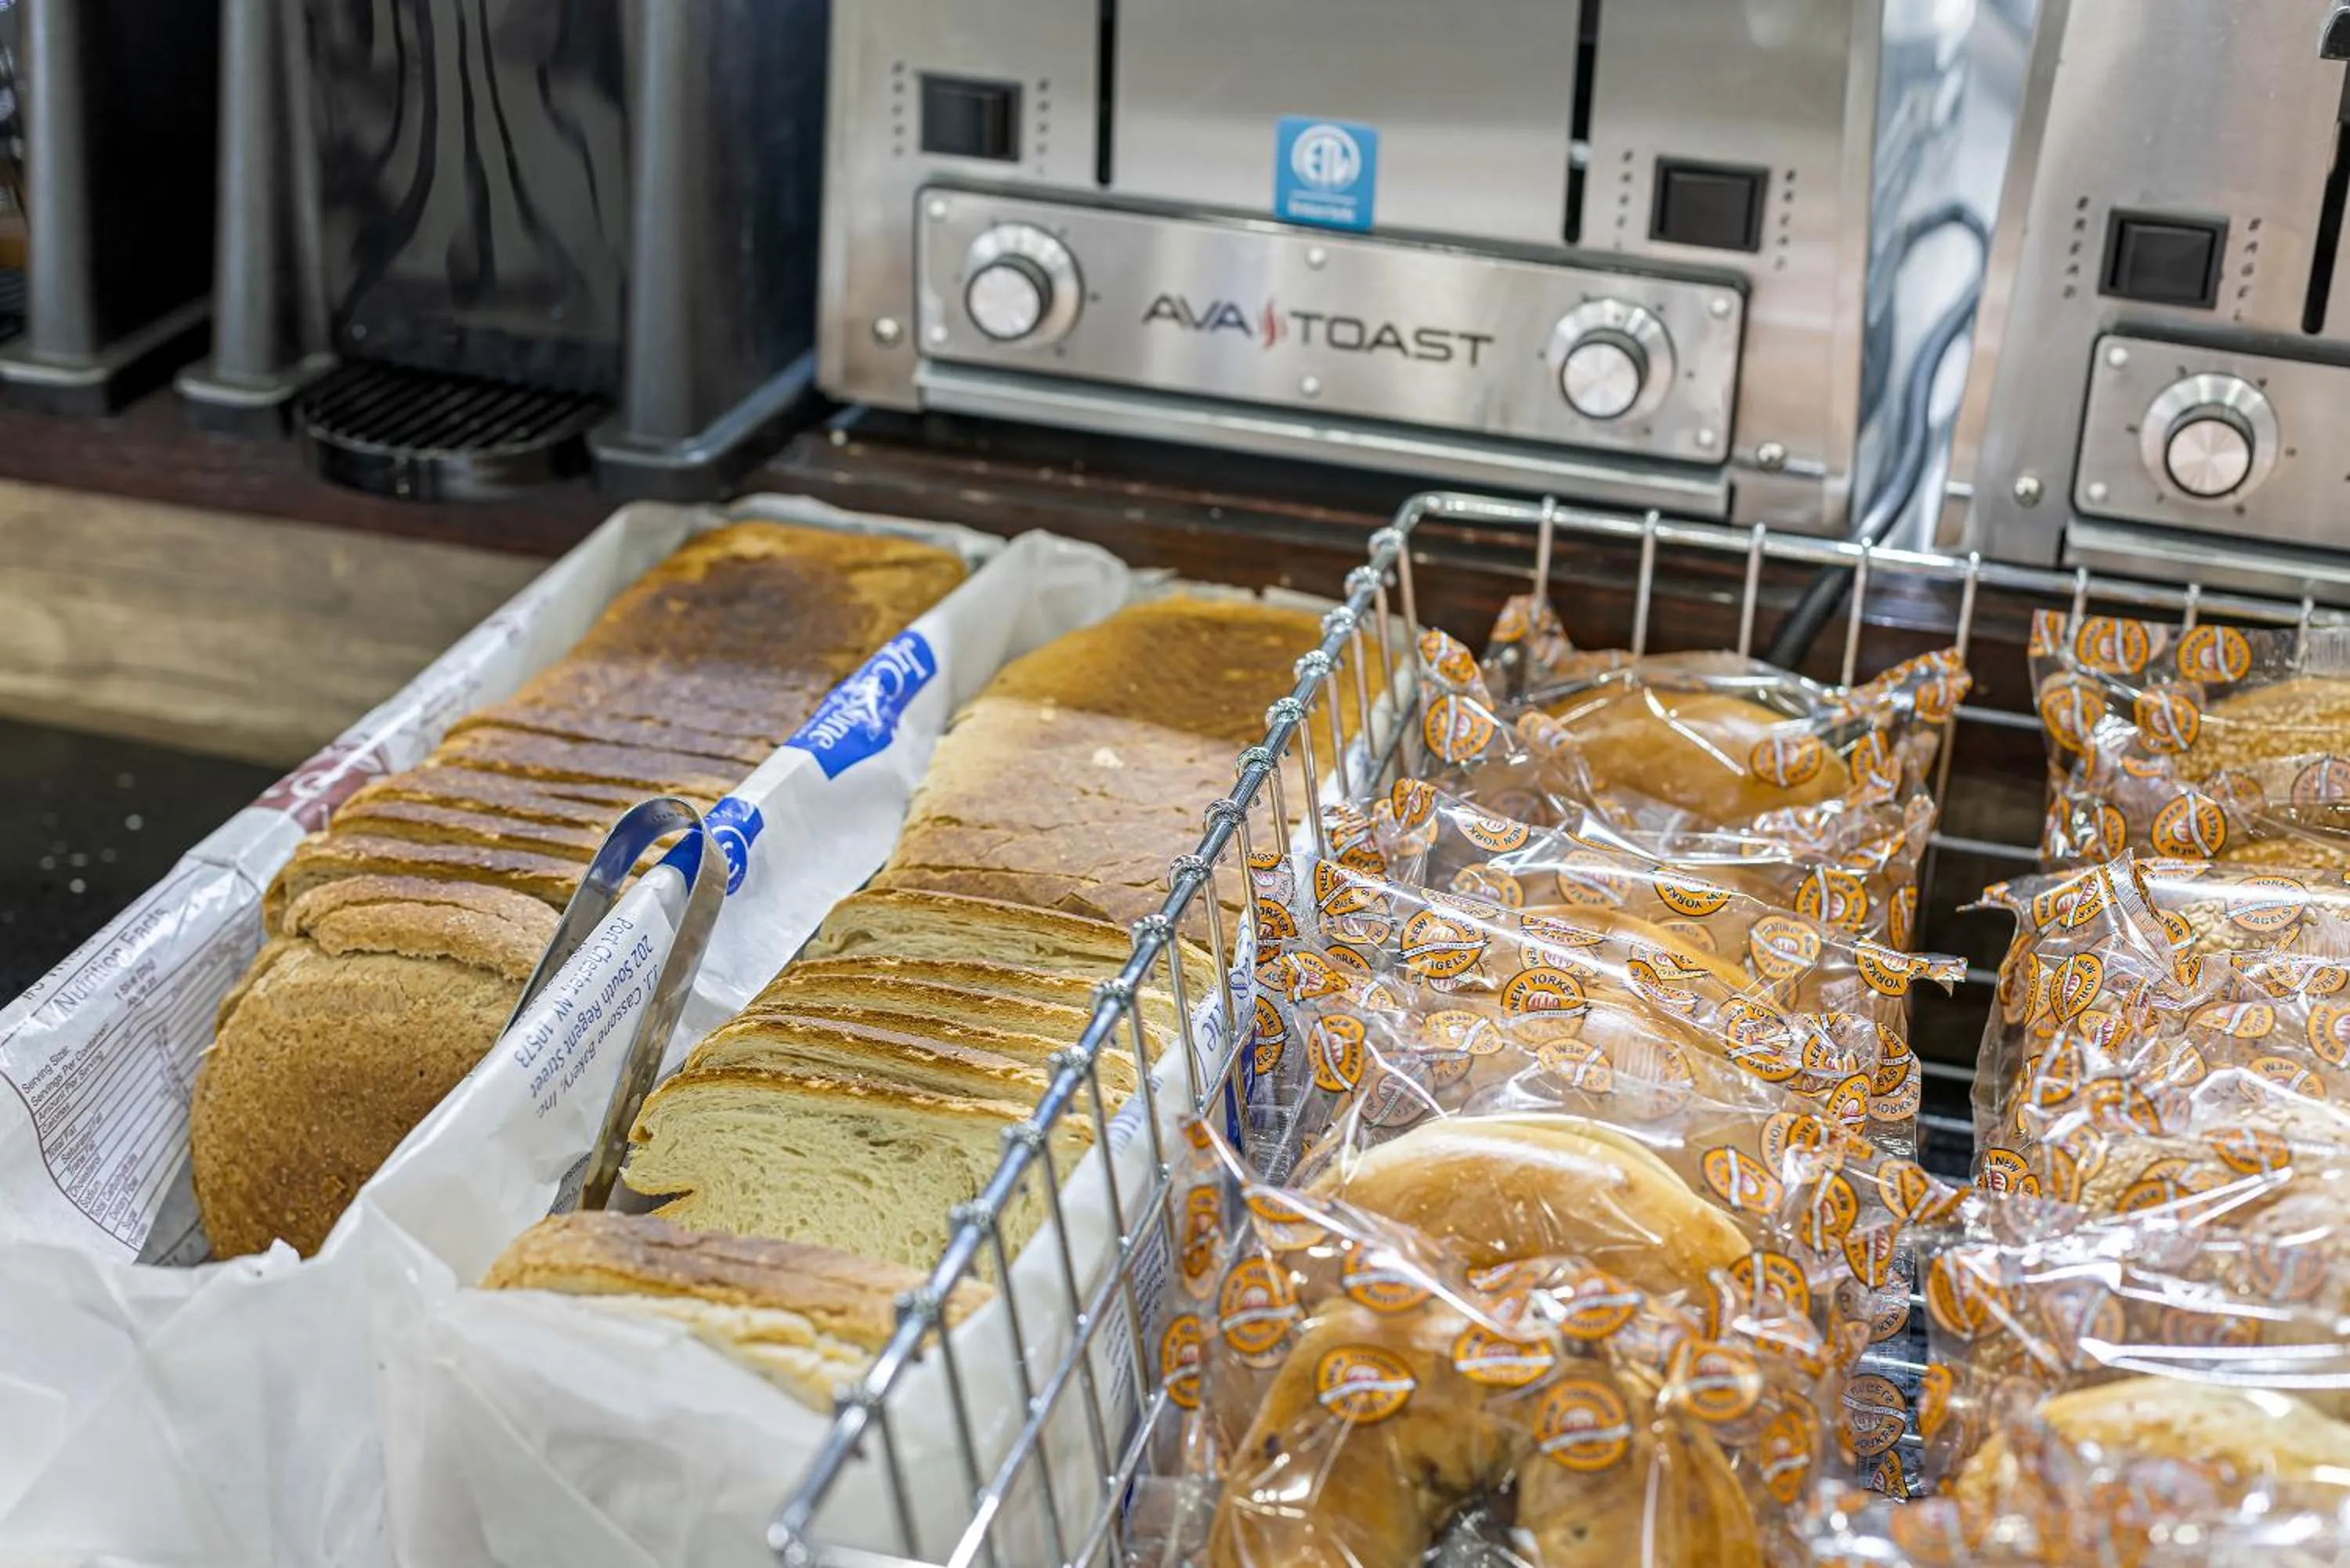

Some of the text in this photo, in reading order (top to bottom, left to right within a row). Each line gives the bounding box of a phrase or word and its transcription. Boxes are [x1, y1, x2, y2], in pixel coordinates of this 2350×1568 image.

[1142, 294, 1495, 367] AVA TOAST
[1503, 827, 1521, 845] NEW
[601, 916, 634, 945] Port
[631, 934, 654, 968] 202
[561, 945, 613, 995] Chester,
[602, 959, 634, 1006] South
[555, 997, 573, 1023] NY
[598, 988, 642, 1045] Cassone
[1509, 982, 1528, 1012] NEW
[515, 1021, 555, 1068] 10573
[564, 1000, 602, 1054] Regent
[22, 1064, 53, 1094] Serving
[31, 1072, 63, 1106] Servings
[63, 1062, 76, 1076] Per
[530, 1049, 566, 1098] Street
[1995, 1156, 2020, 1173] NEW
